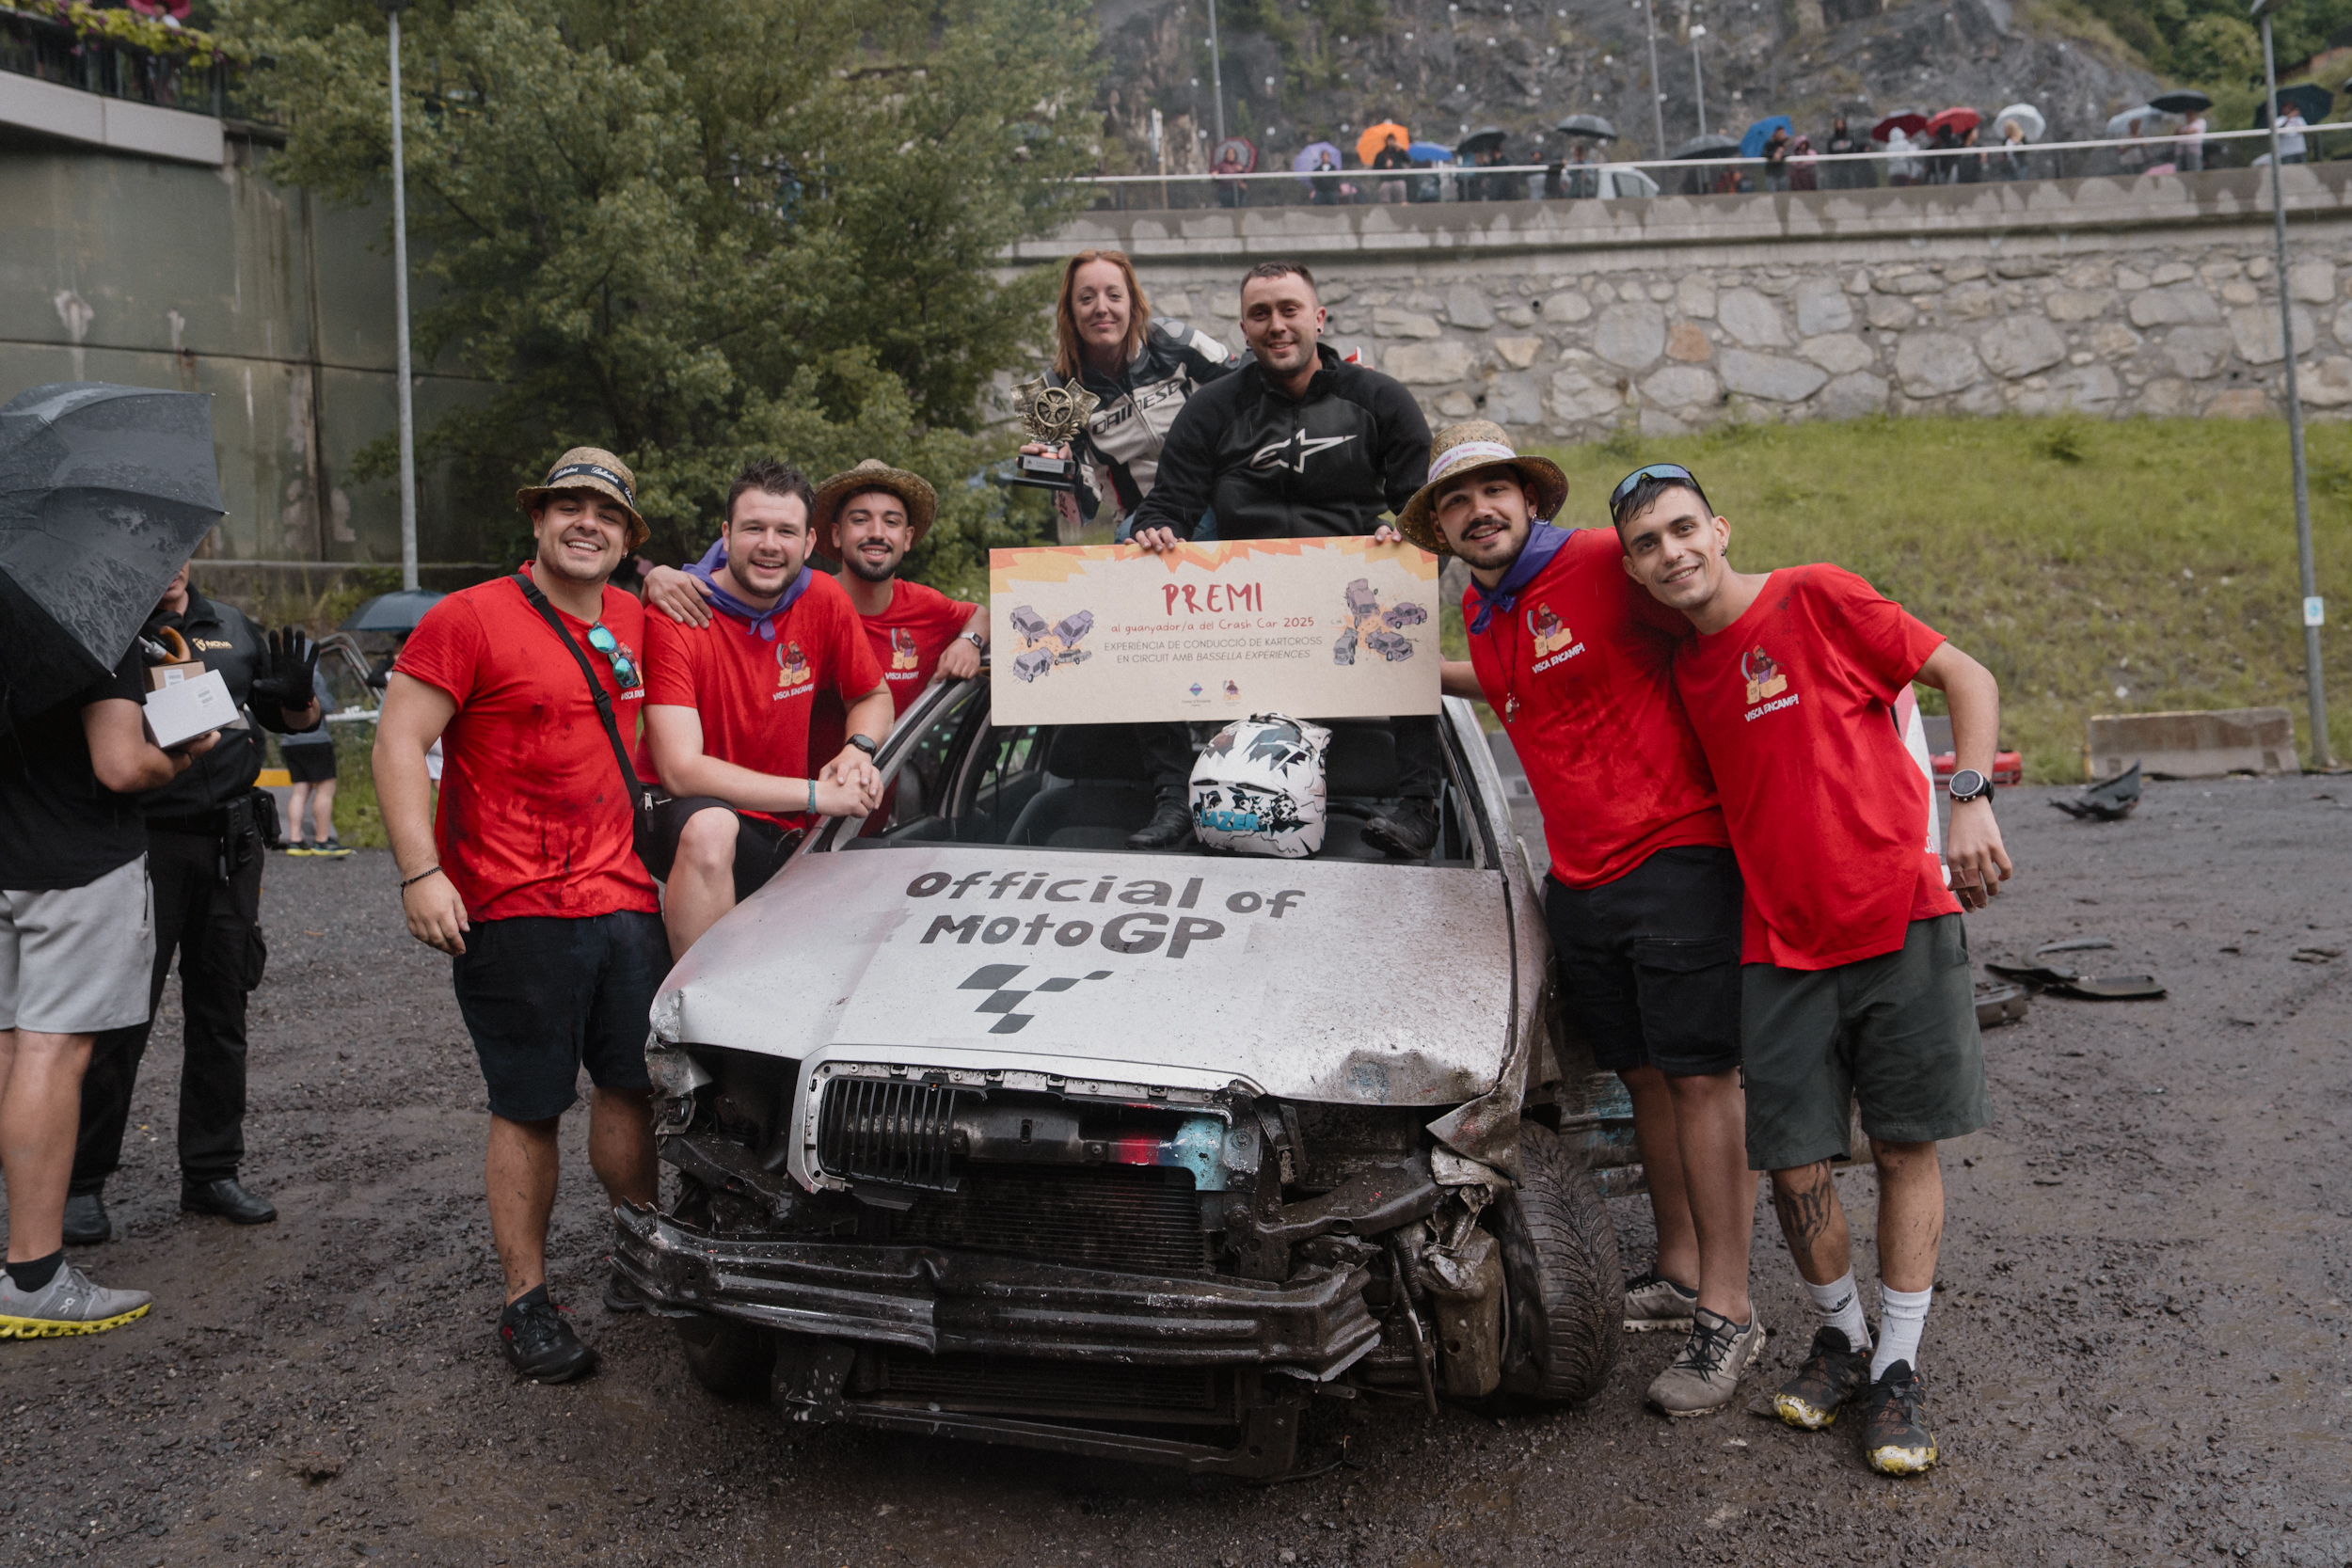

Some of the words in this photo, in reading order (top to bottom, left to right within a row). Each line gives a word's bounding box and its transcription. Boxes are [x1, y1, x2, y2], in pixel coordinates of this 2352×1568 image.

[1161, 582, 1263, 616] PREMI
[1111, 624, 1120, 633] al
[1125, 622, 1195, 636] guanyador/a
[1200, 620, 1214, 630] del
[1218, 619, 1252, 630] Crash
[1257, 617, 1279, 629] Car
[1283, 616, 1315, 627] 2025
[1117, 654, 1130, 664] EN
[1132, 654, 1169, 663] CIRCUIT
[1172, 653, 1194, 662] AMB
[1196, 652, 1243, 662] BASSELLA
[1245, 649, 1311, 660] EXPERIENCES
[1168, 640, 1181, 650] DE
[1184, 637, 1247, 649] CONDUCCIÓ
[1249, 639, 1263, 647] DE
[1264, 636, 1323, 646] KARTCROSS
[1532, 659, 1551, 673] VISCA
[1550, 641, 1585, 666] ENCAMP!
[772, 689, 791, 701] VISCA
[1744, 706, 1764, 722] VISCA
[1763, 693, 1799, 714] ENCAMP!
[1201, 807, 1261, 832] LAZER
[906, 871, 1204, 910] Official
[1225, 890, 1306, 918] of
[919, 912, 1226, 959] MotoGP
